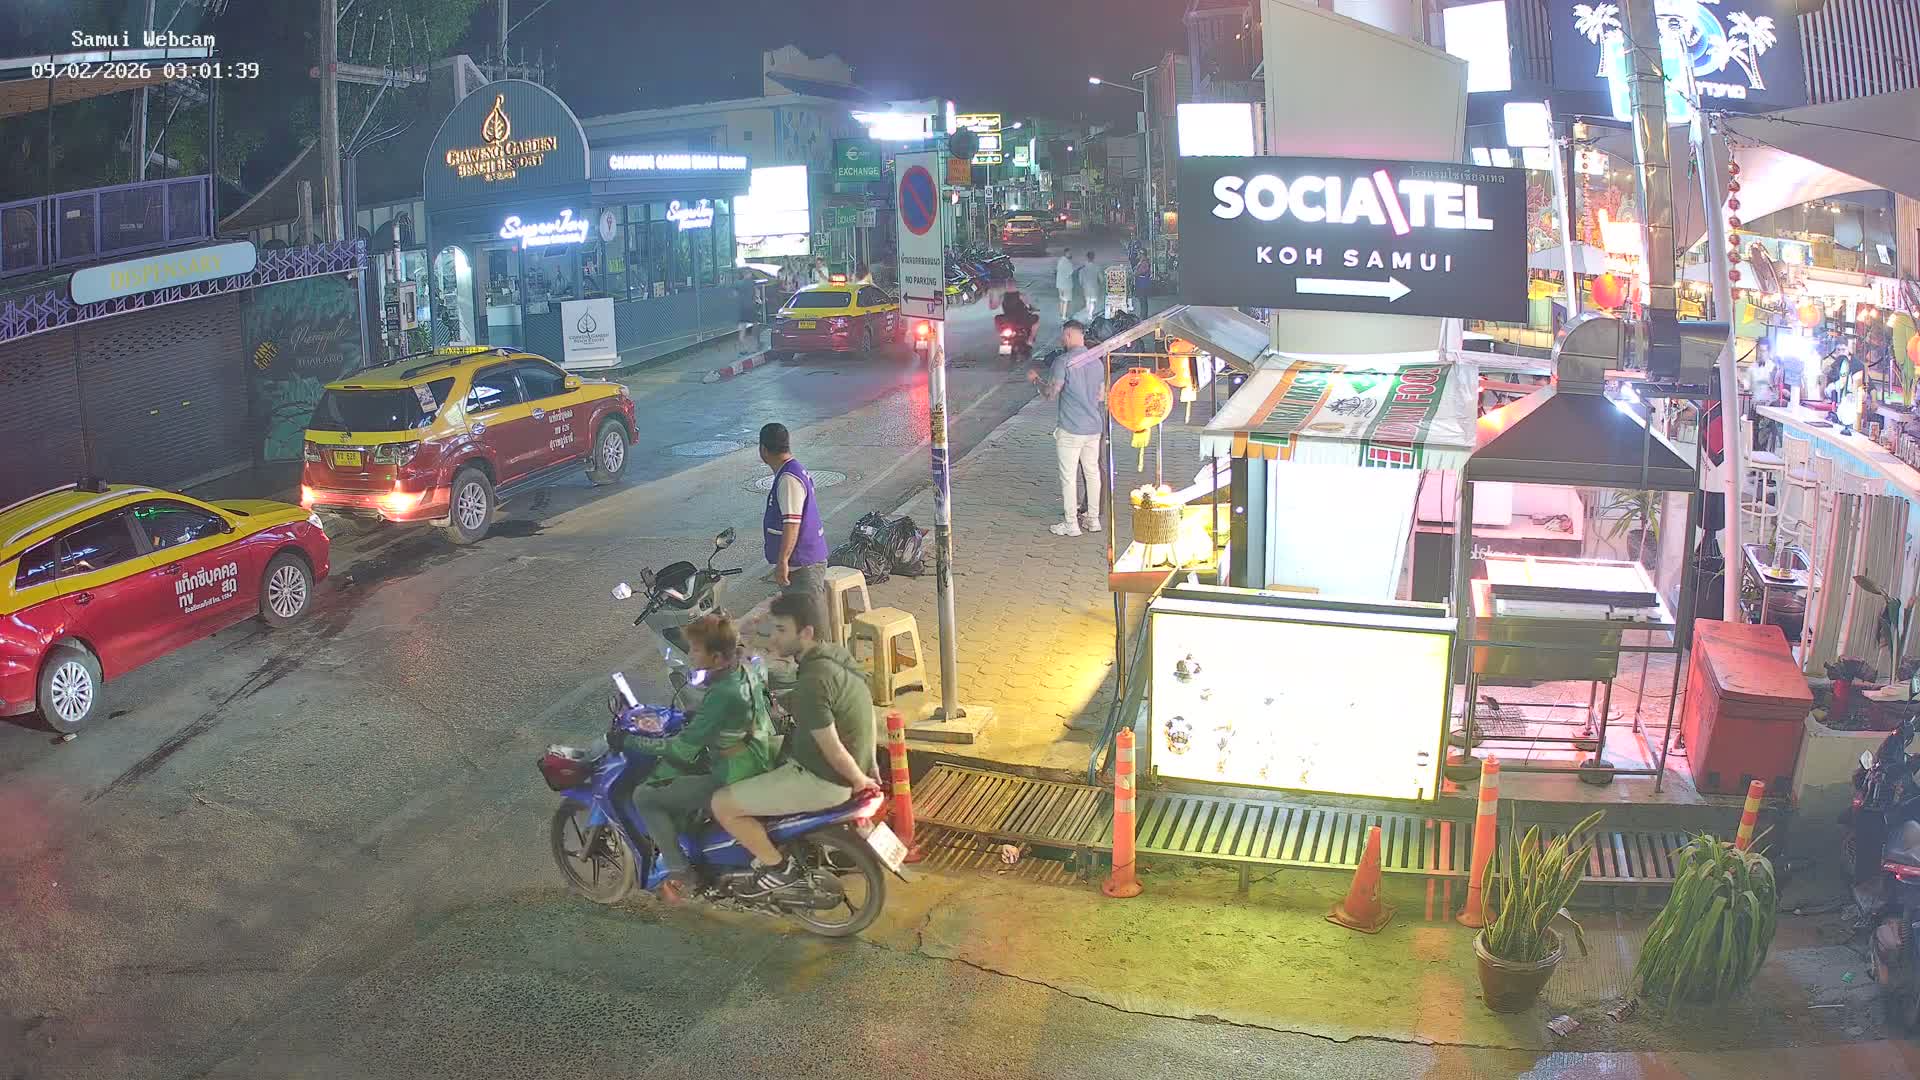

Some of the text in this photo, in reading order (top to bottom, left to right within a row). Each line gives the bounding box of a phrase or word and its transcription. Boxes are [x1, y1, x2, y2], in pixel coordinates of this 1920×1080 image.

[839, 167, 879, 176] EXCHANGE
[1256, 246, 1452, 272] KOH SAMUI
[111, 257, 223, 291] DISPENSARY
[905, 276, 937, 286] NO PARKING
